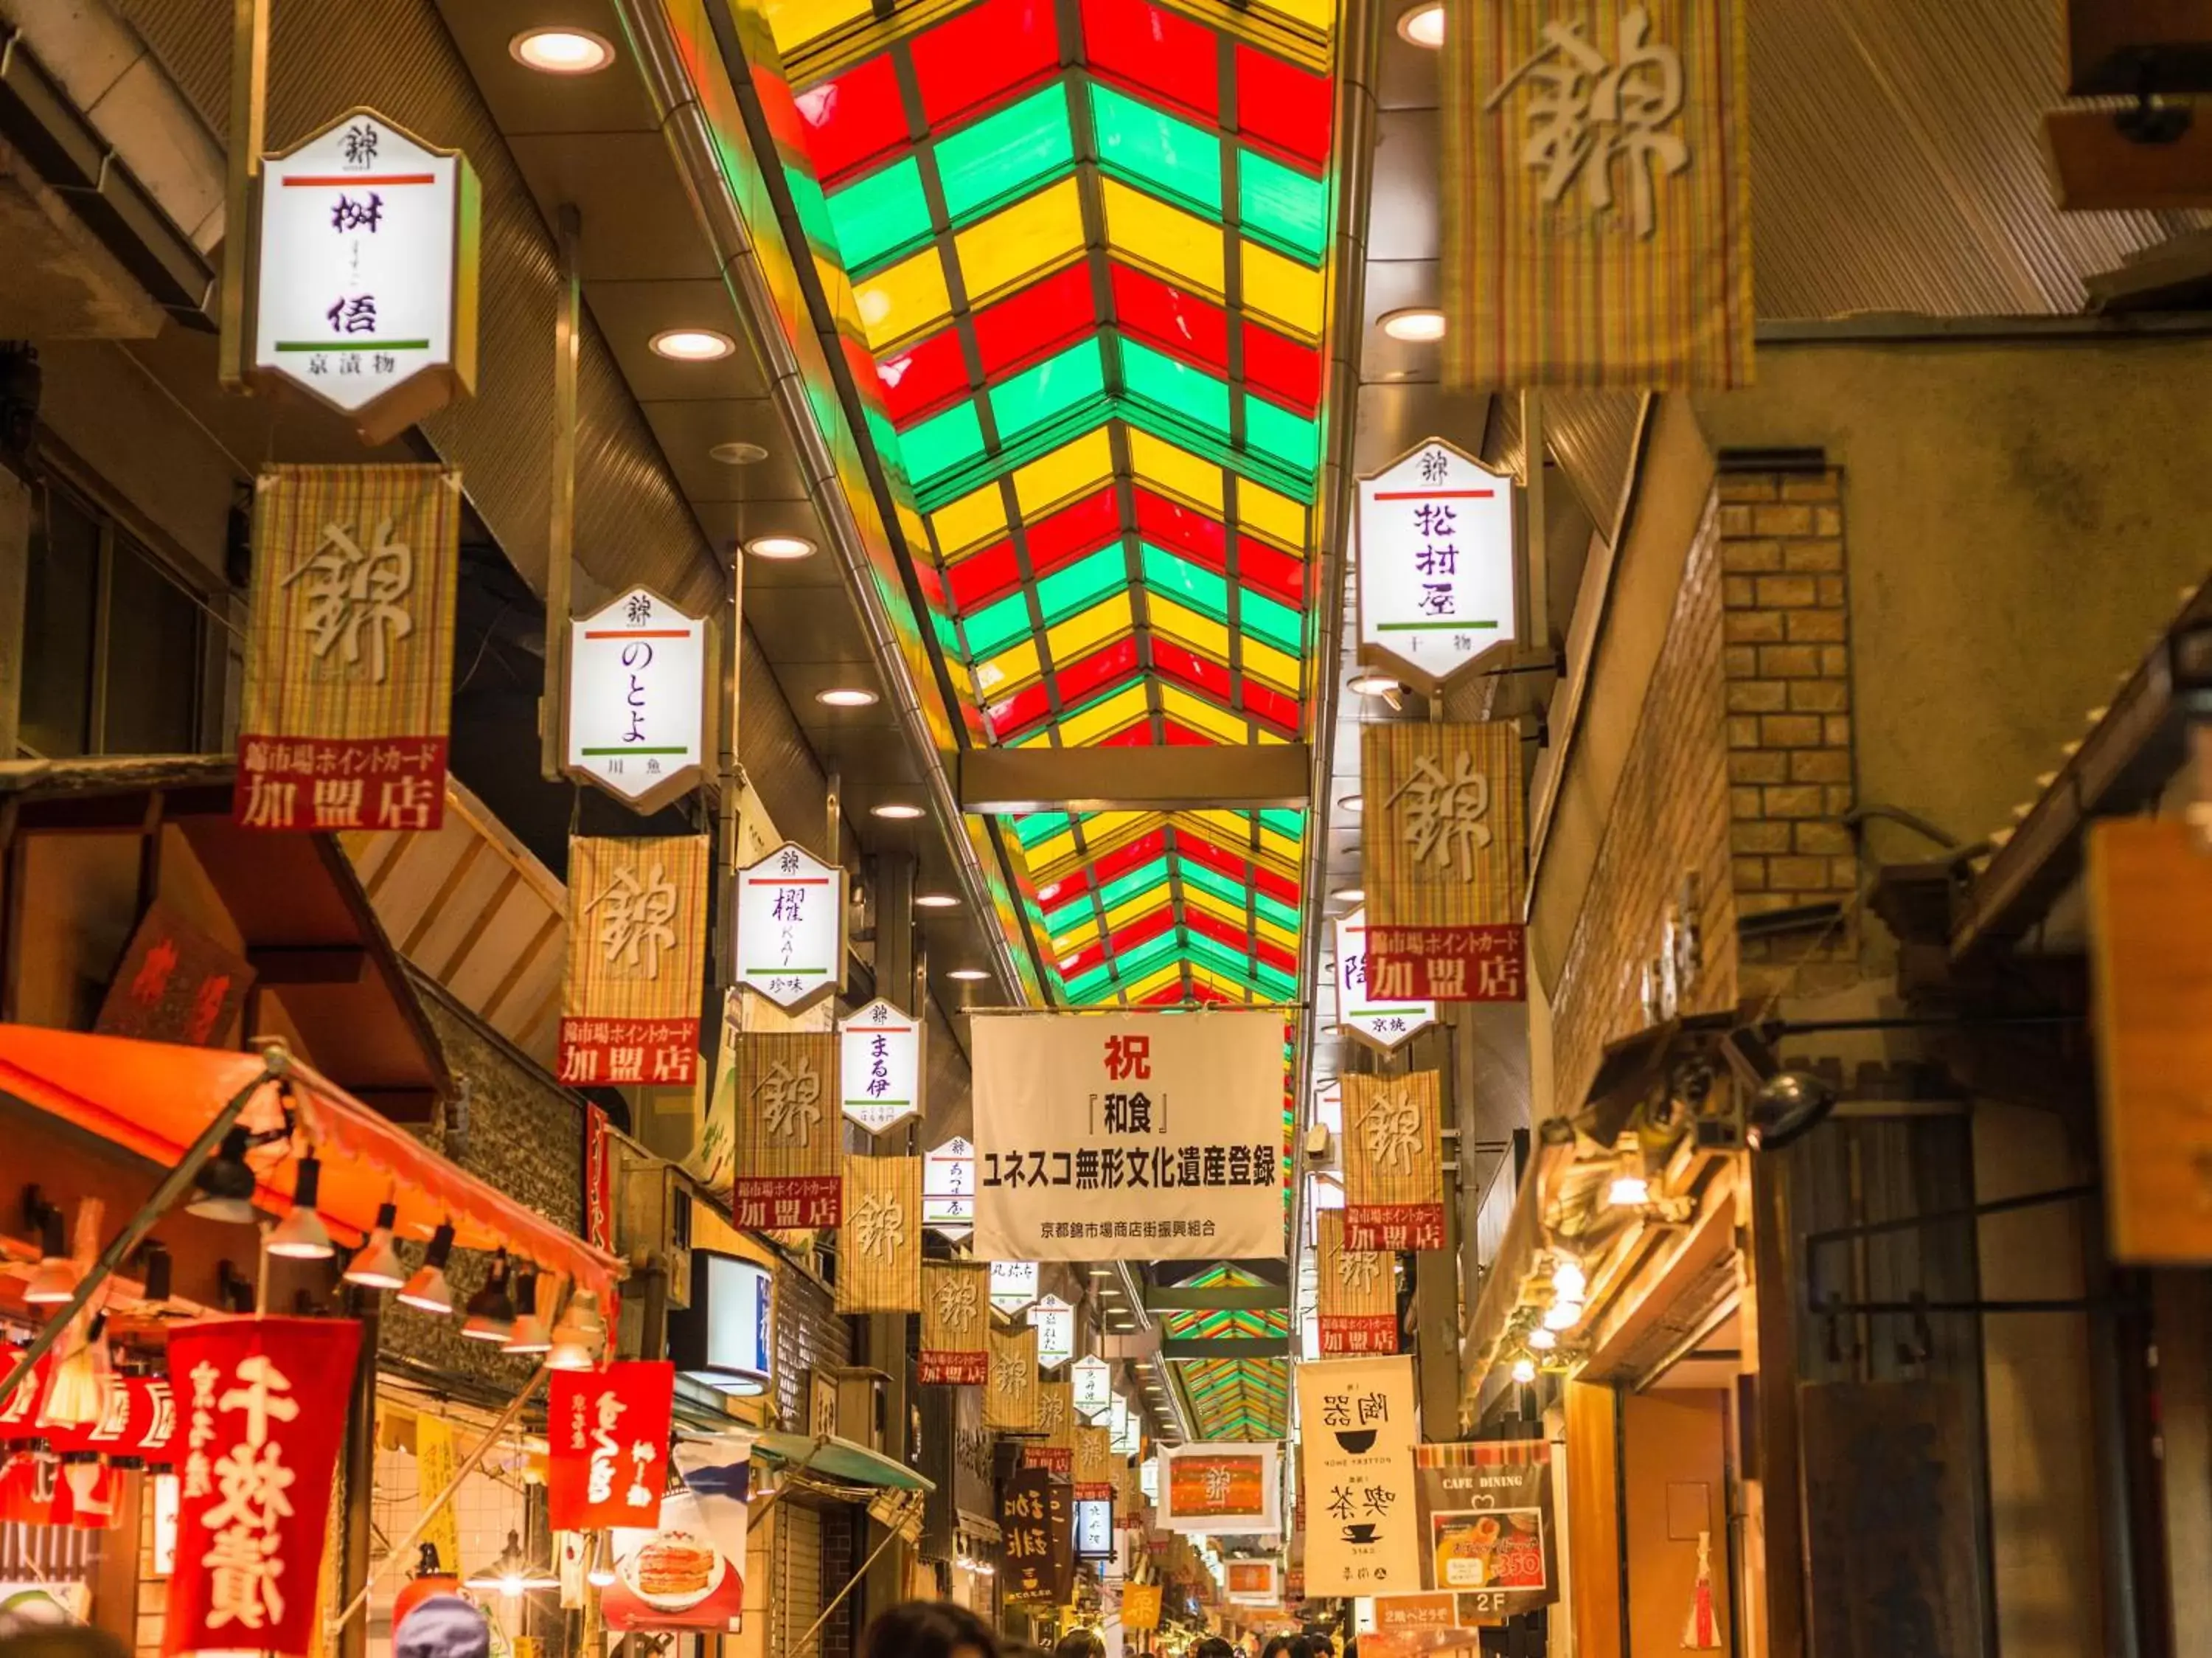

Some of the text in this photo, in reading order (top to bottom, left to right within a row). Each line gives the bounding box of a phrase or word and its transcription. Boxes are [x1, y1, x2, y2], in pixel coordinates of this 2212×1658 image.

[310, 353, 394, 375] 京漬物
[1414, 504, 1458, 616] 松村屋
[622, 641, 653, 743] のとよ
[609, 758, 661, 774] 川魚
[241, 774, 435, 828] 加盟店
[781, 926, 793, 966] KAI
[769, 977, 803, 993] 珍味
[1371, 955, 1519, 998] 加盟店
[560, 1044, 693, 1081] 加盟店
[866, 1034, 891, 1098] まる伊
[1104, 1036, 1151, 1081] 祝
[1089, 1093, 1167, 1135] 『和食』
[983, 1145, 1276, 1189] ユネスコ無形文化遺産登録
[738, 1198, 838, 1227] 加盟店
[1040, 1219, 1216, 1239] 京都錦市場商店街振興組合
[1350, 1224, 1441, 1250] 加盟店
[1324, 1329, 1394, 1350] 加盟店
[1443, 1475, 1523, 1489] CAFE DINING
[1477, 1592, 1506, 1612] 2F
